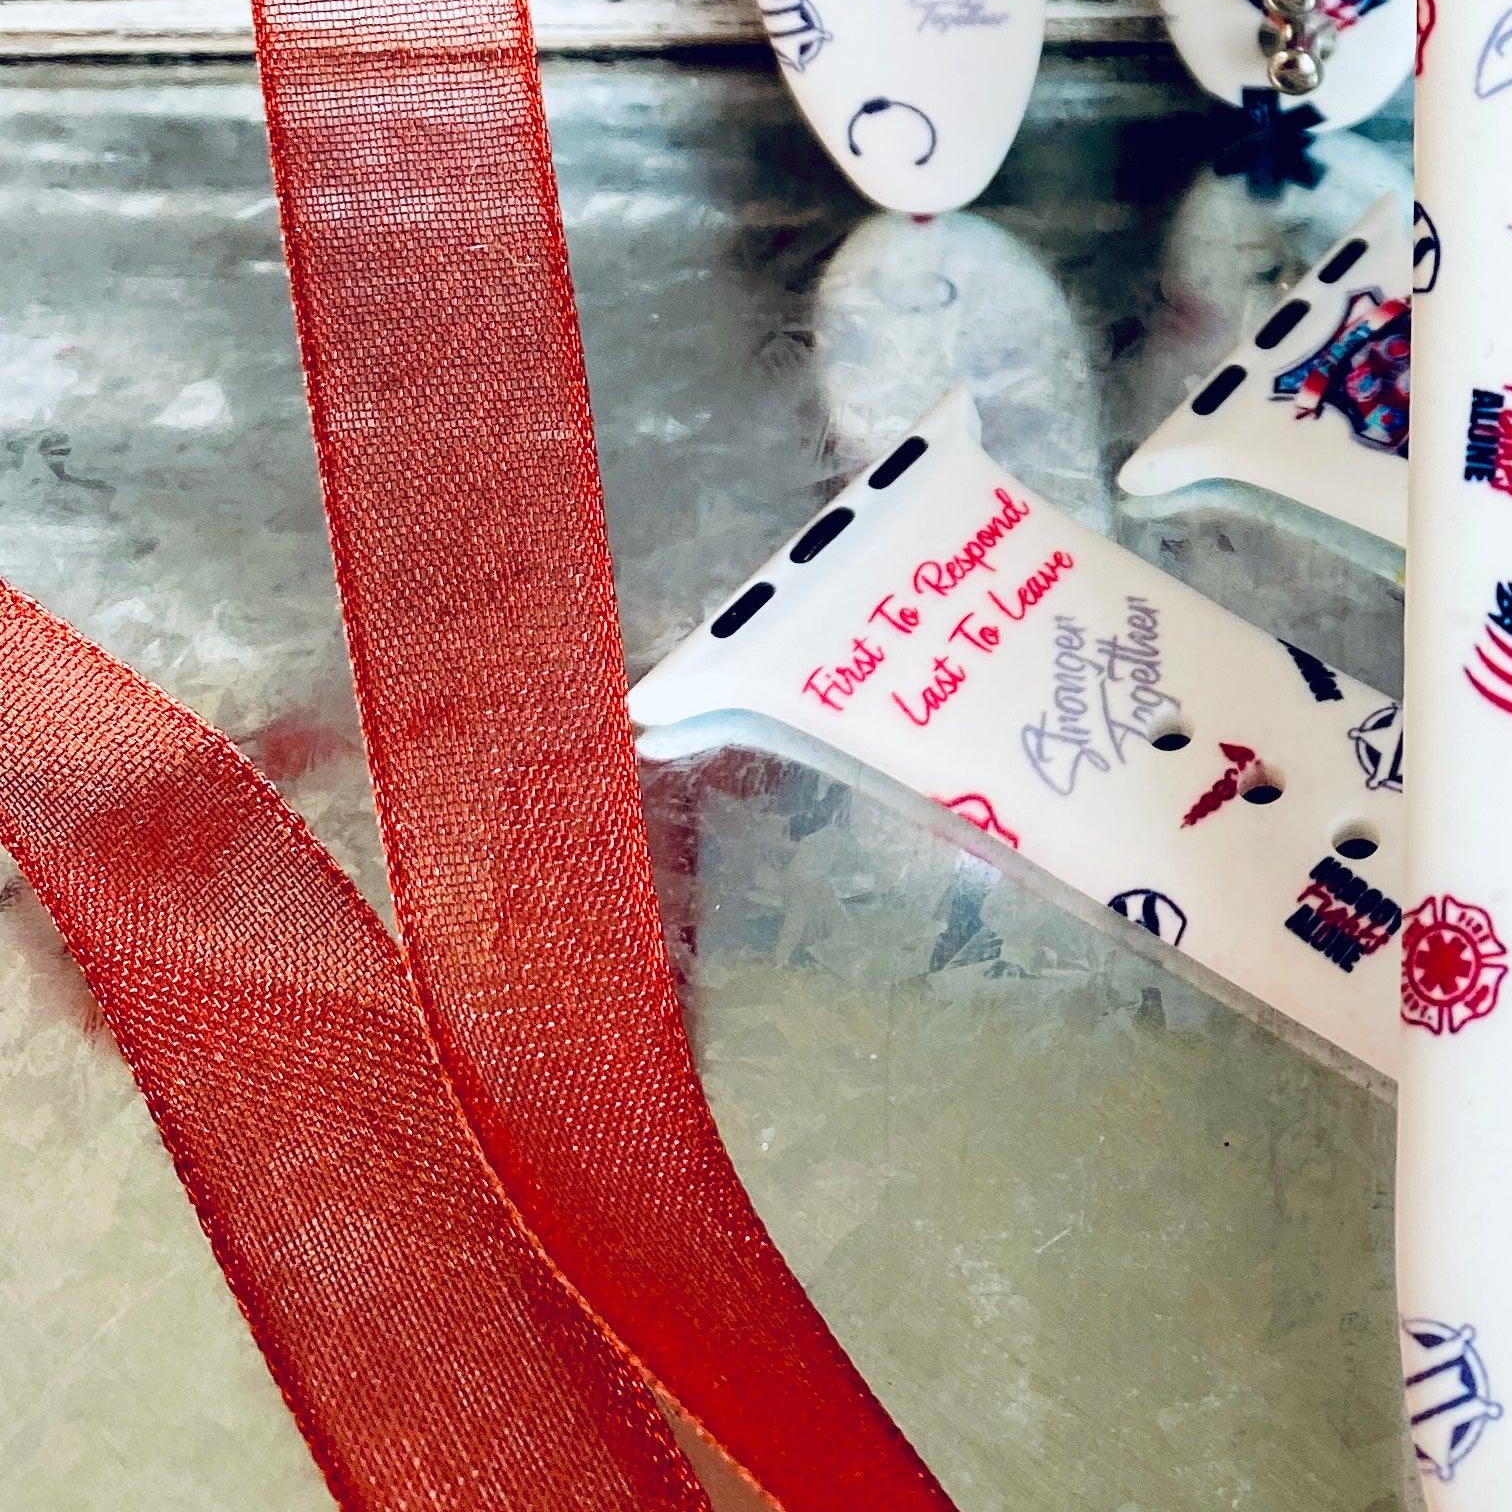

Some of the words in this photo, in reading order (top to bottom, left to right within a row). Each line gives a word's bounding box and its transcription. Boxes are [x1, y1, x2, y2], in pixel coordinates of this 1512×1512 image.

[1464, 388, 1504, 483] ALONE
[802, 636, 885, 711] First
[868, 593, 921, 634] To
[913, 487, 1030, 597] Respond
[892, 655, 967, 727] Last
[948, 612, 999, 654] To
[987, 550, 1075, 621] Leave
[1020, 615, 1111, 796] Stronger
